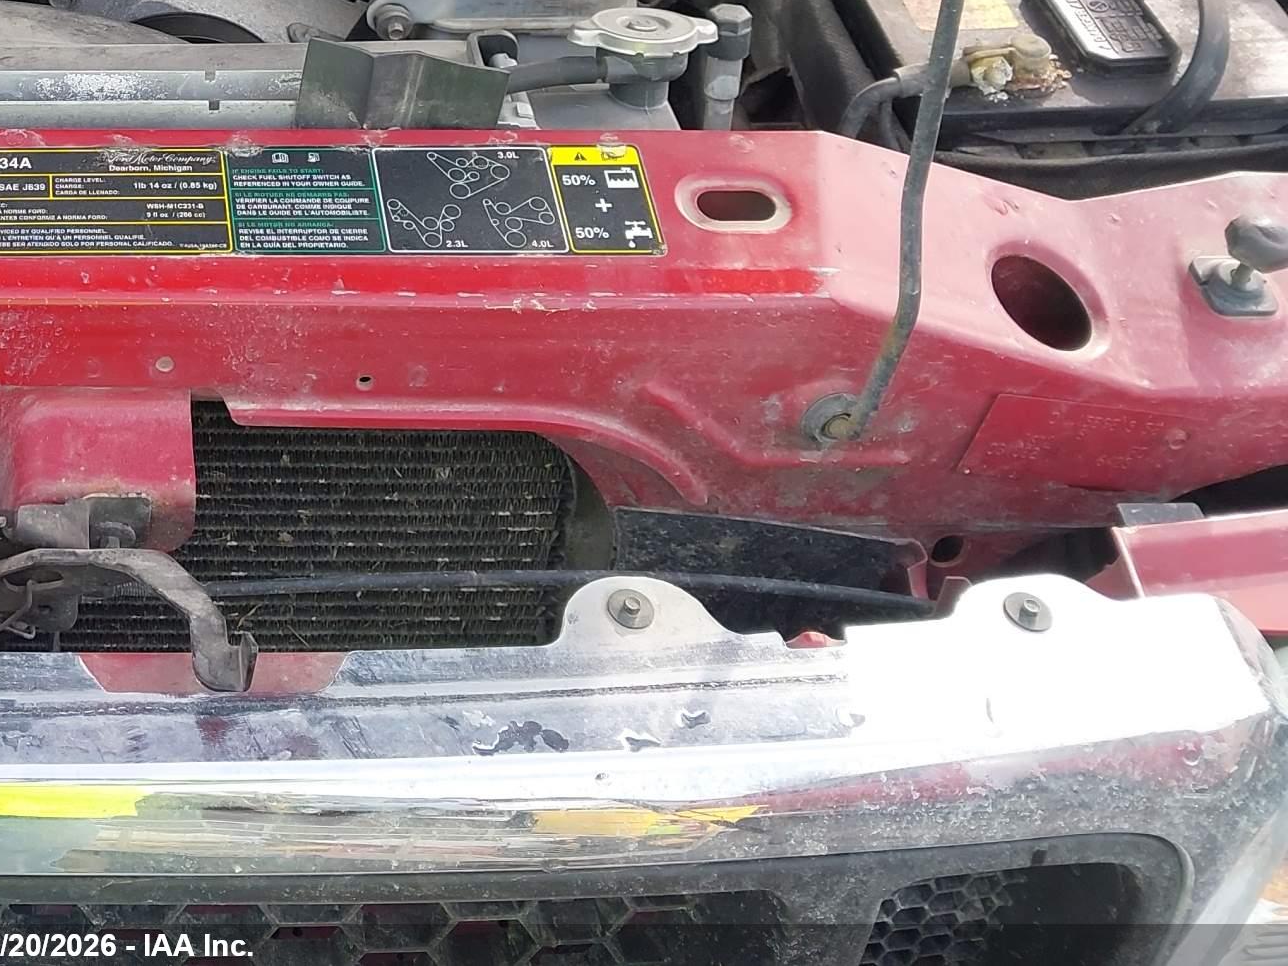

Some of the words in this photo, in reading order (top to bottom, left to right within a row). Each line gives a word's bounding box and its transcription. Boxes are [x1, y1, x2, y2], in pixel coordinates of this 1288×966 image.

[132, 152, 163, 165] Motor
[162, 154, 216, 166] Company
[497, 151, 519, 159] 3.0L
[562, 174, 596, 186] 50%
[179, 182, 201, 190] (0.85
[203, 182, 217, 190] kg)
[575, 227, 609, 239] 50%
[446, 240, 469, 248] 2.3L
[531, 240, 554, 248] 4.0L
